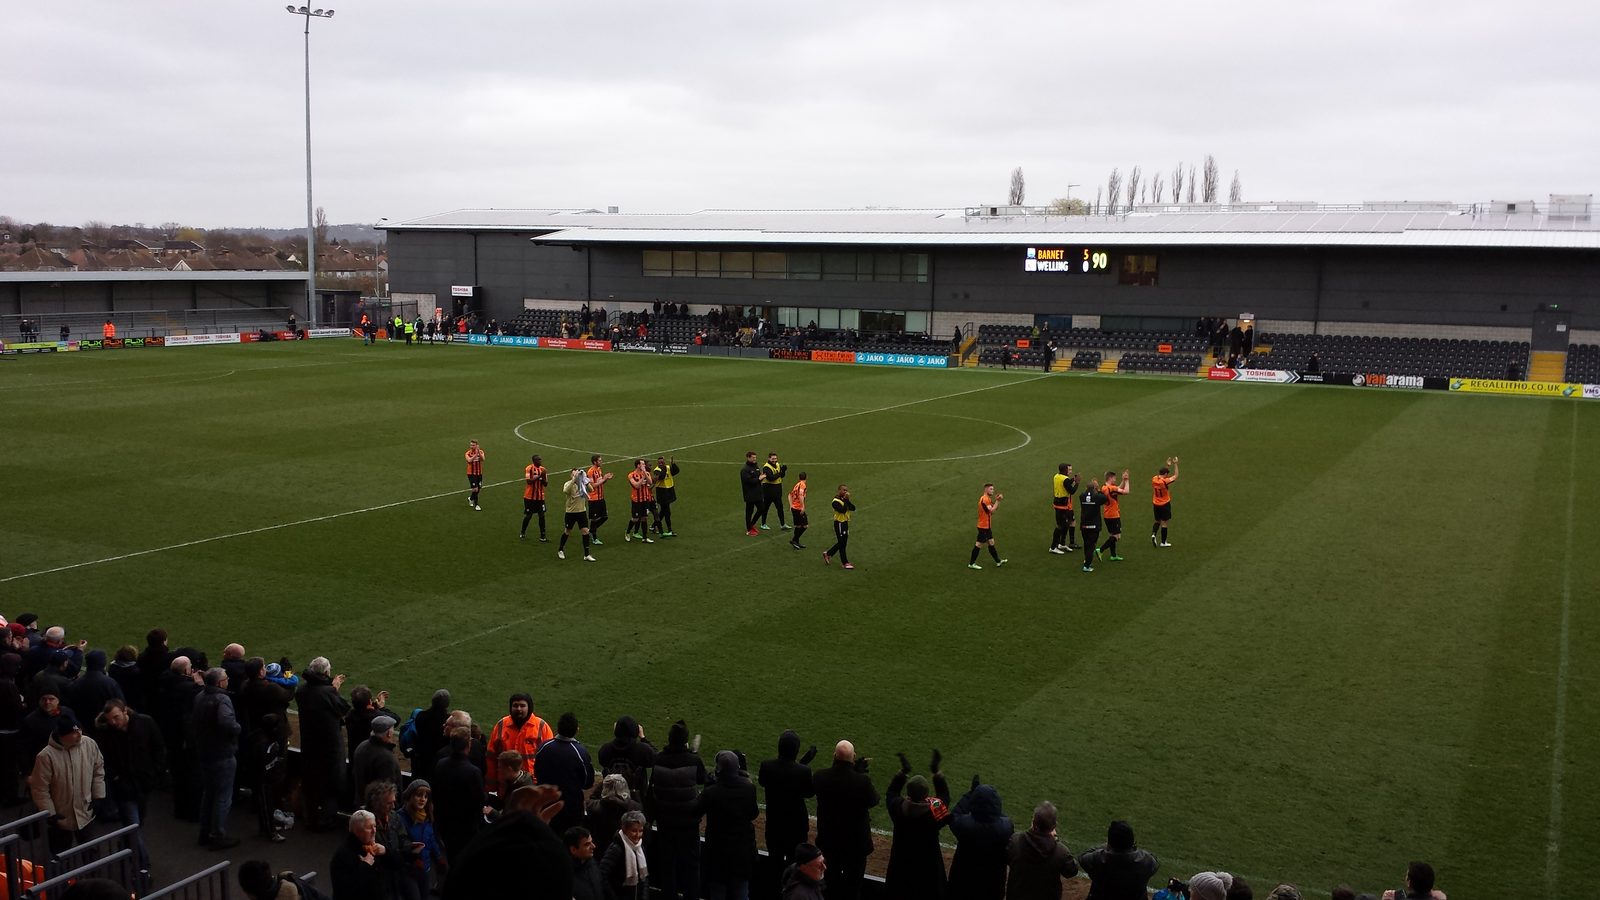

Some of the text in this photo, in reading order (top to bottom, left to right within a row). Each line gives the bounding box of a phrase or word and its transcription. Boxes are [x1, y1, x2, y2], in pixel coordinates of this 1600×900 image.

[1038, 249, 1089, 260] BARNET 5
[1037, 261, 1069, 271] WELLING
[1092, 253, 1107, 269] 90
[476, 335, 488, 343] JAK
[895, 356, 915, 364] JAKO
[926, 357, 946, 365] JAKO
[1470, 380, 1561, 392] REGALLITHO.CO.UK
